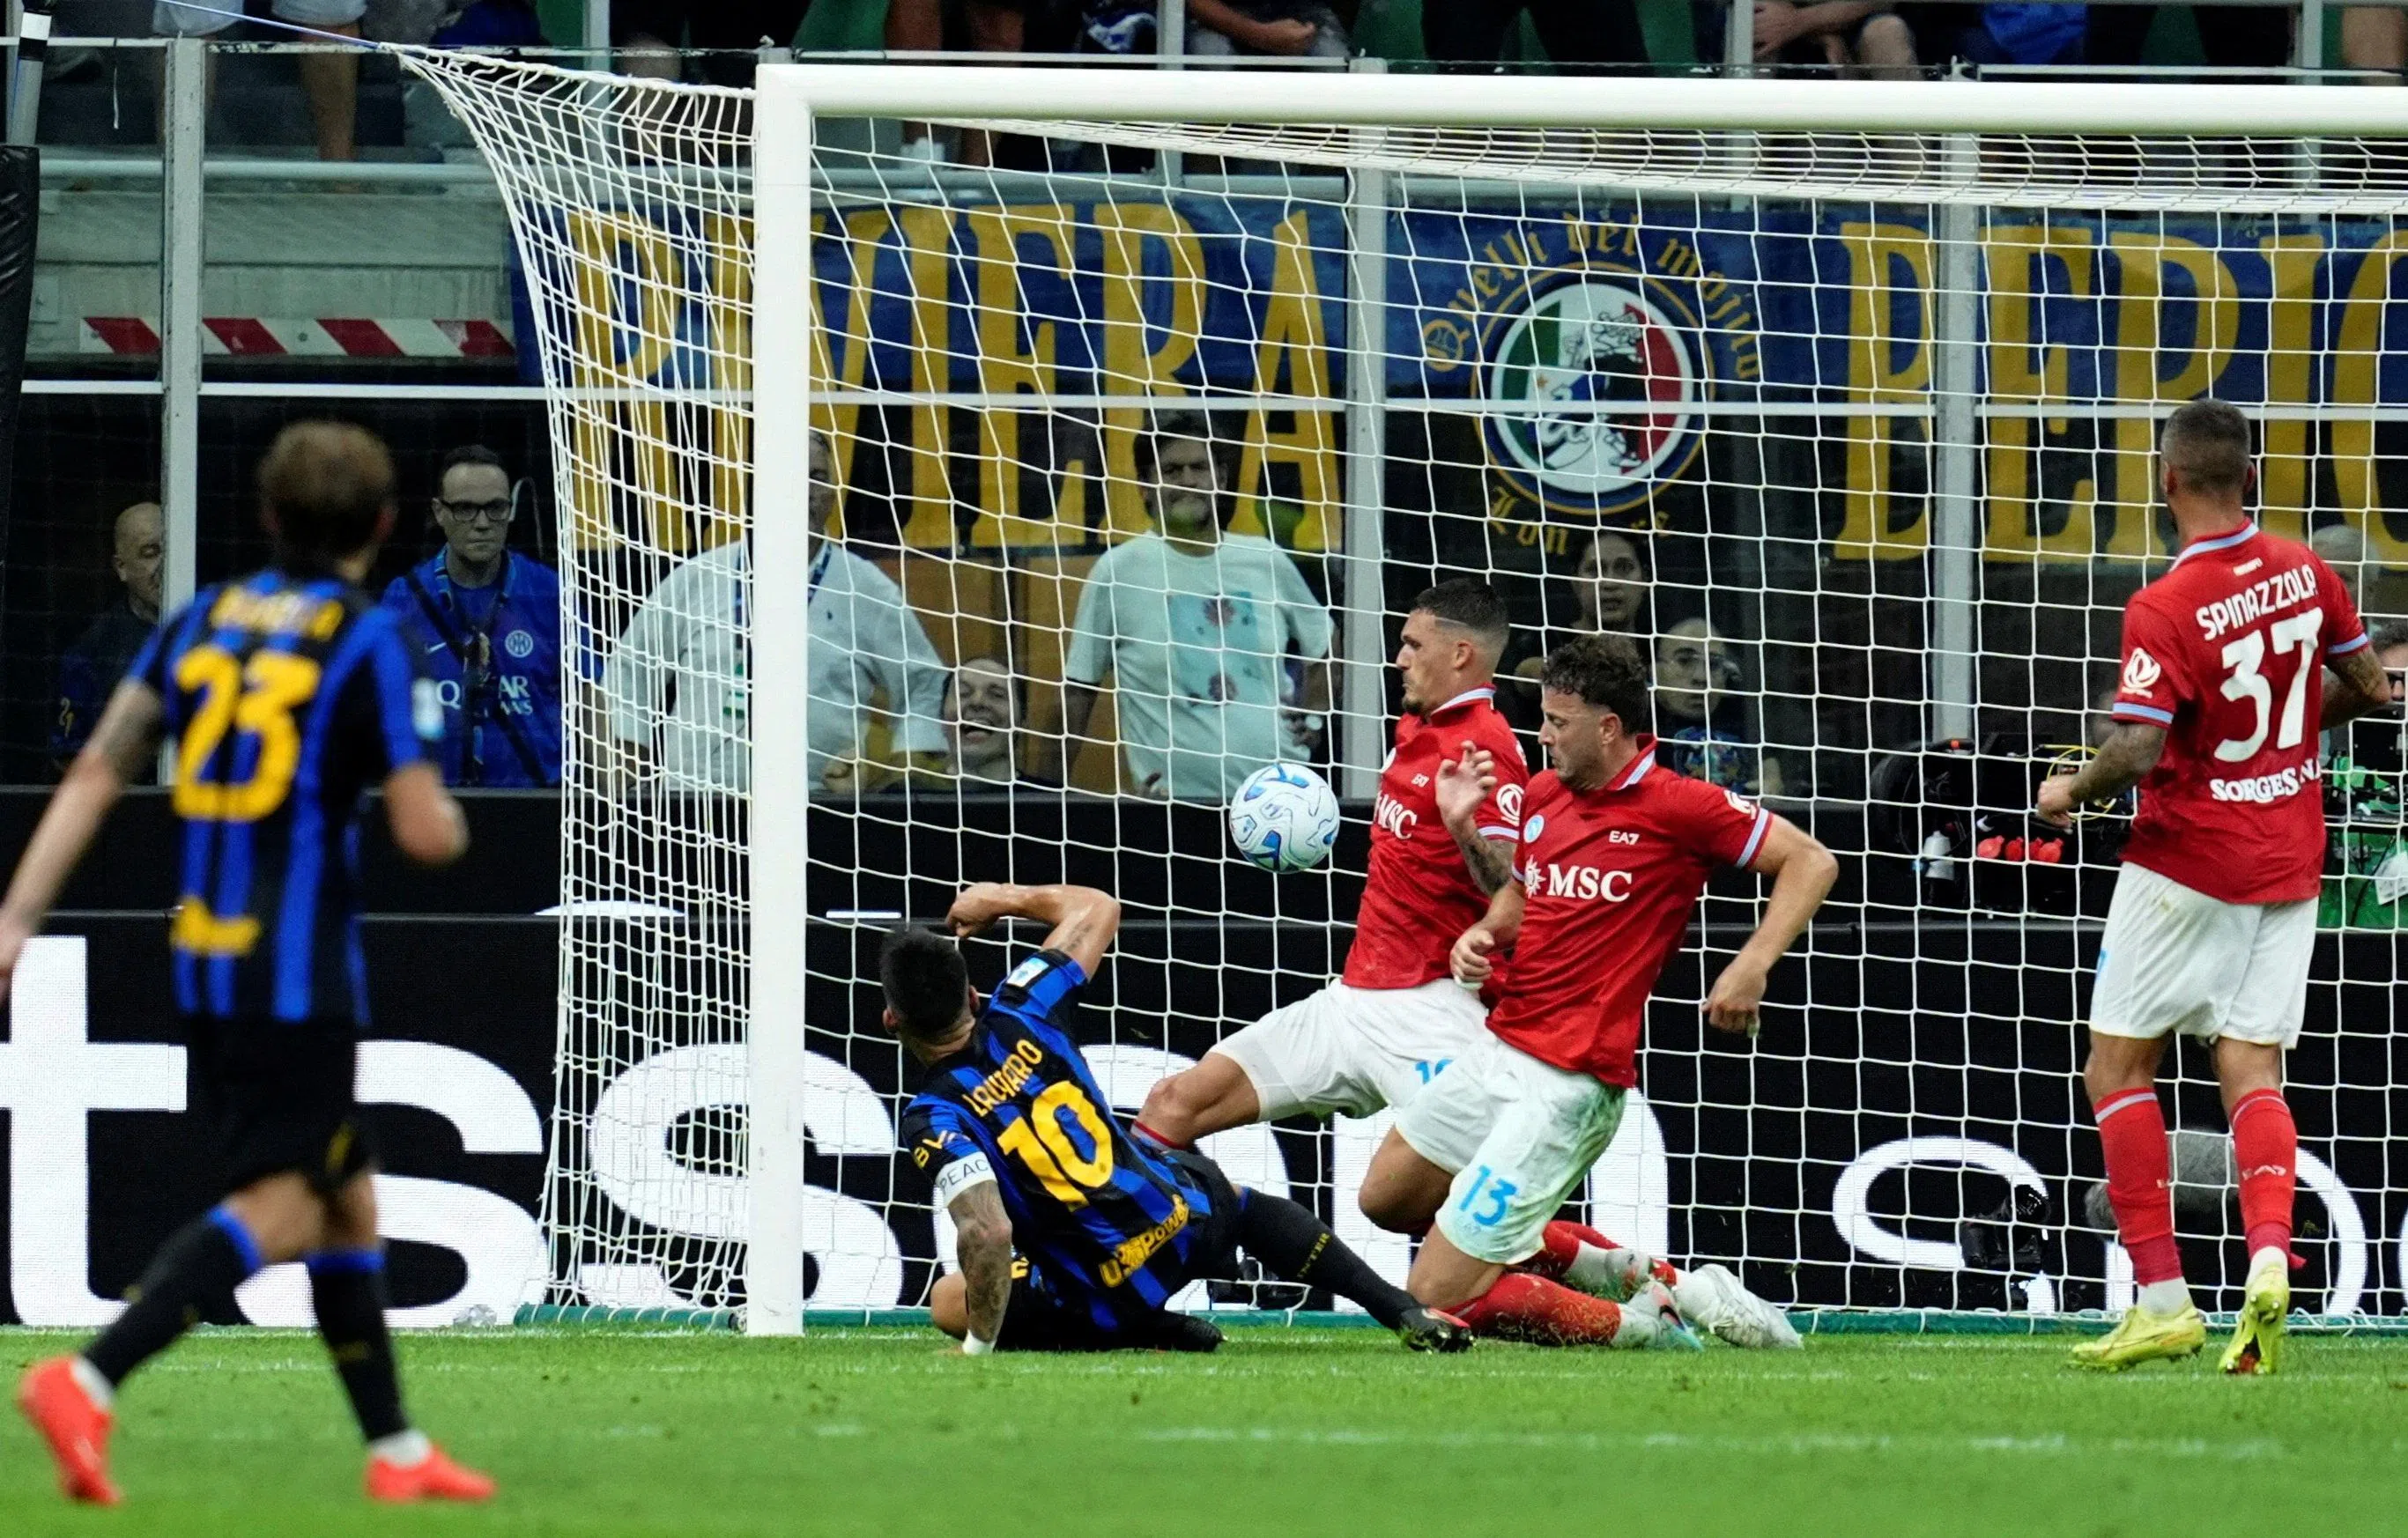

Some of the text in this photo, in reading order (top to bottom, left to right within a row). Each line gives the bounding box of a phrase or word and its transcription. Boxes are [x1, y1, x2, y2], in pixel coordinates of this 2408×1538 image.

[2196, 564, 2319, 641] SPINAZZOLA
[2213, 606, 2324, 763] 37
[173, 642, 322, 823] 23
[1608, 830, 1641, 846] EA7
[1546, 863, 1633, 903] MSC
[997, 1080, 1115, 1213] 10
[1458, 1165, 1518, 1227] 13
